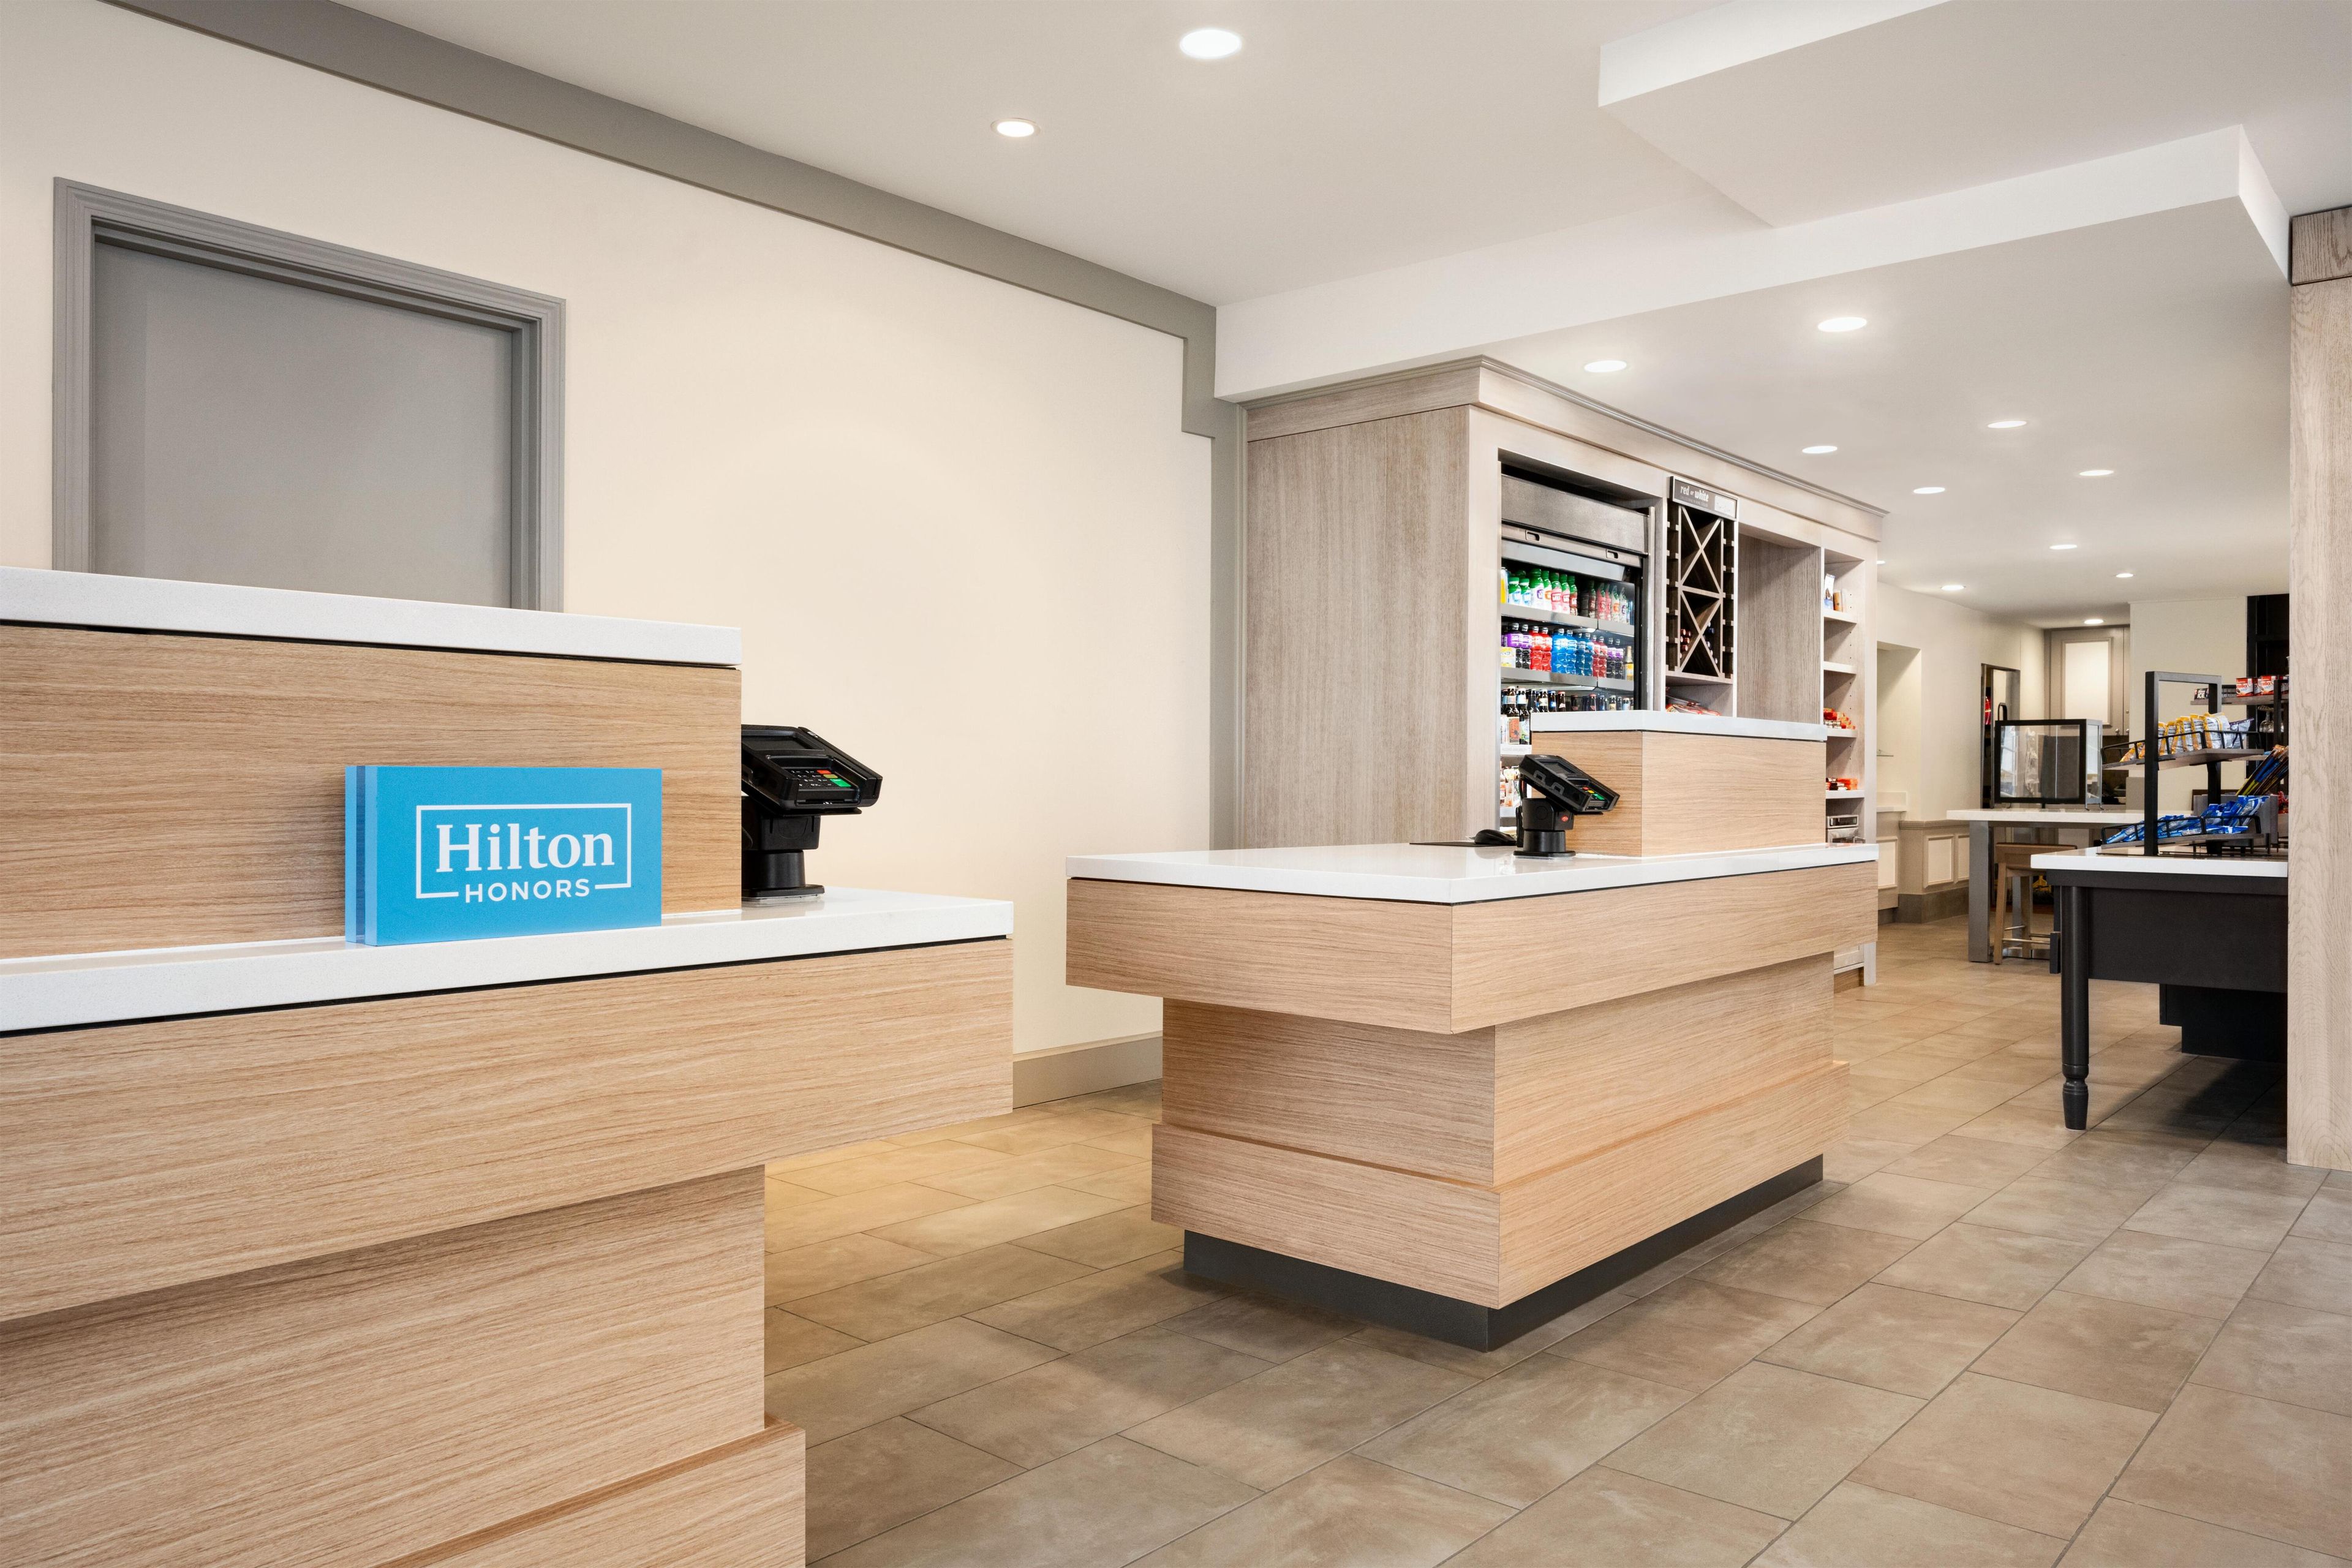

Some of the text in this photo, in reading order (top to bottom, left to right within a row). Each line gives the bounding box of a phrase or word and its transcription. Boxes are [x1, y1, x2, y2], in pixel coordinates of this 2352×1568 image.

[1680, 486, 1689, 496] red
[1694, 489, 1709, 502] white
[435, 823, 615, 873] Hilton
[466, 878, 590, 903] HONORS
